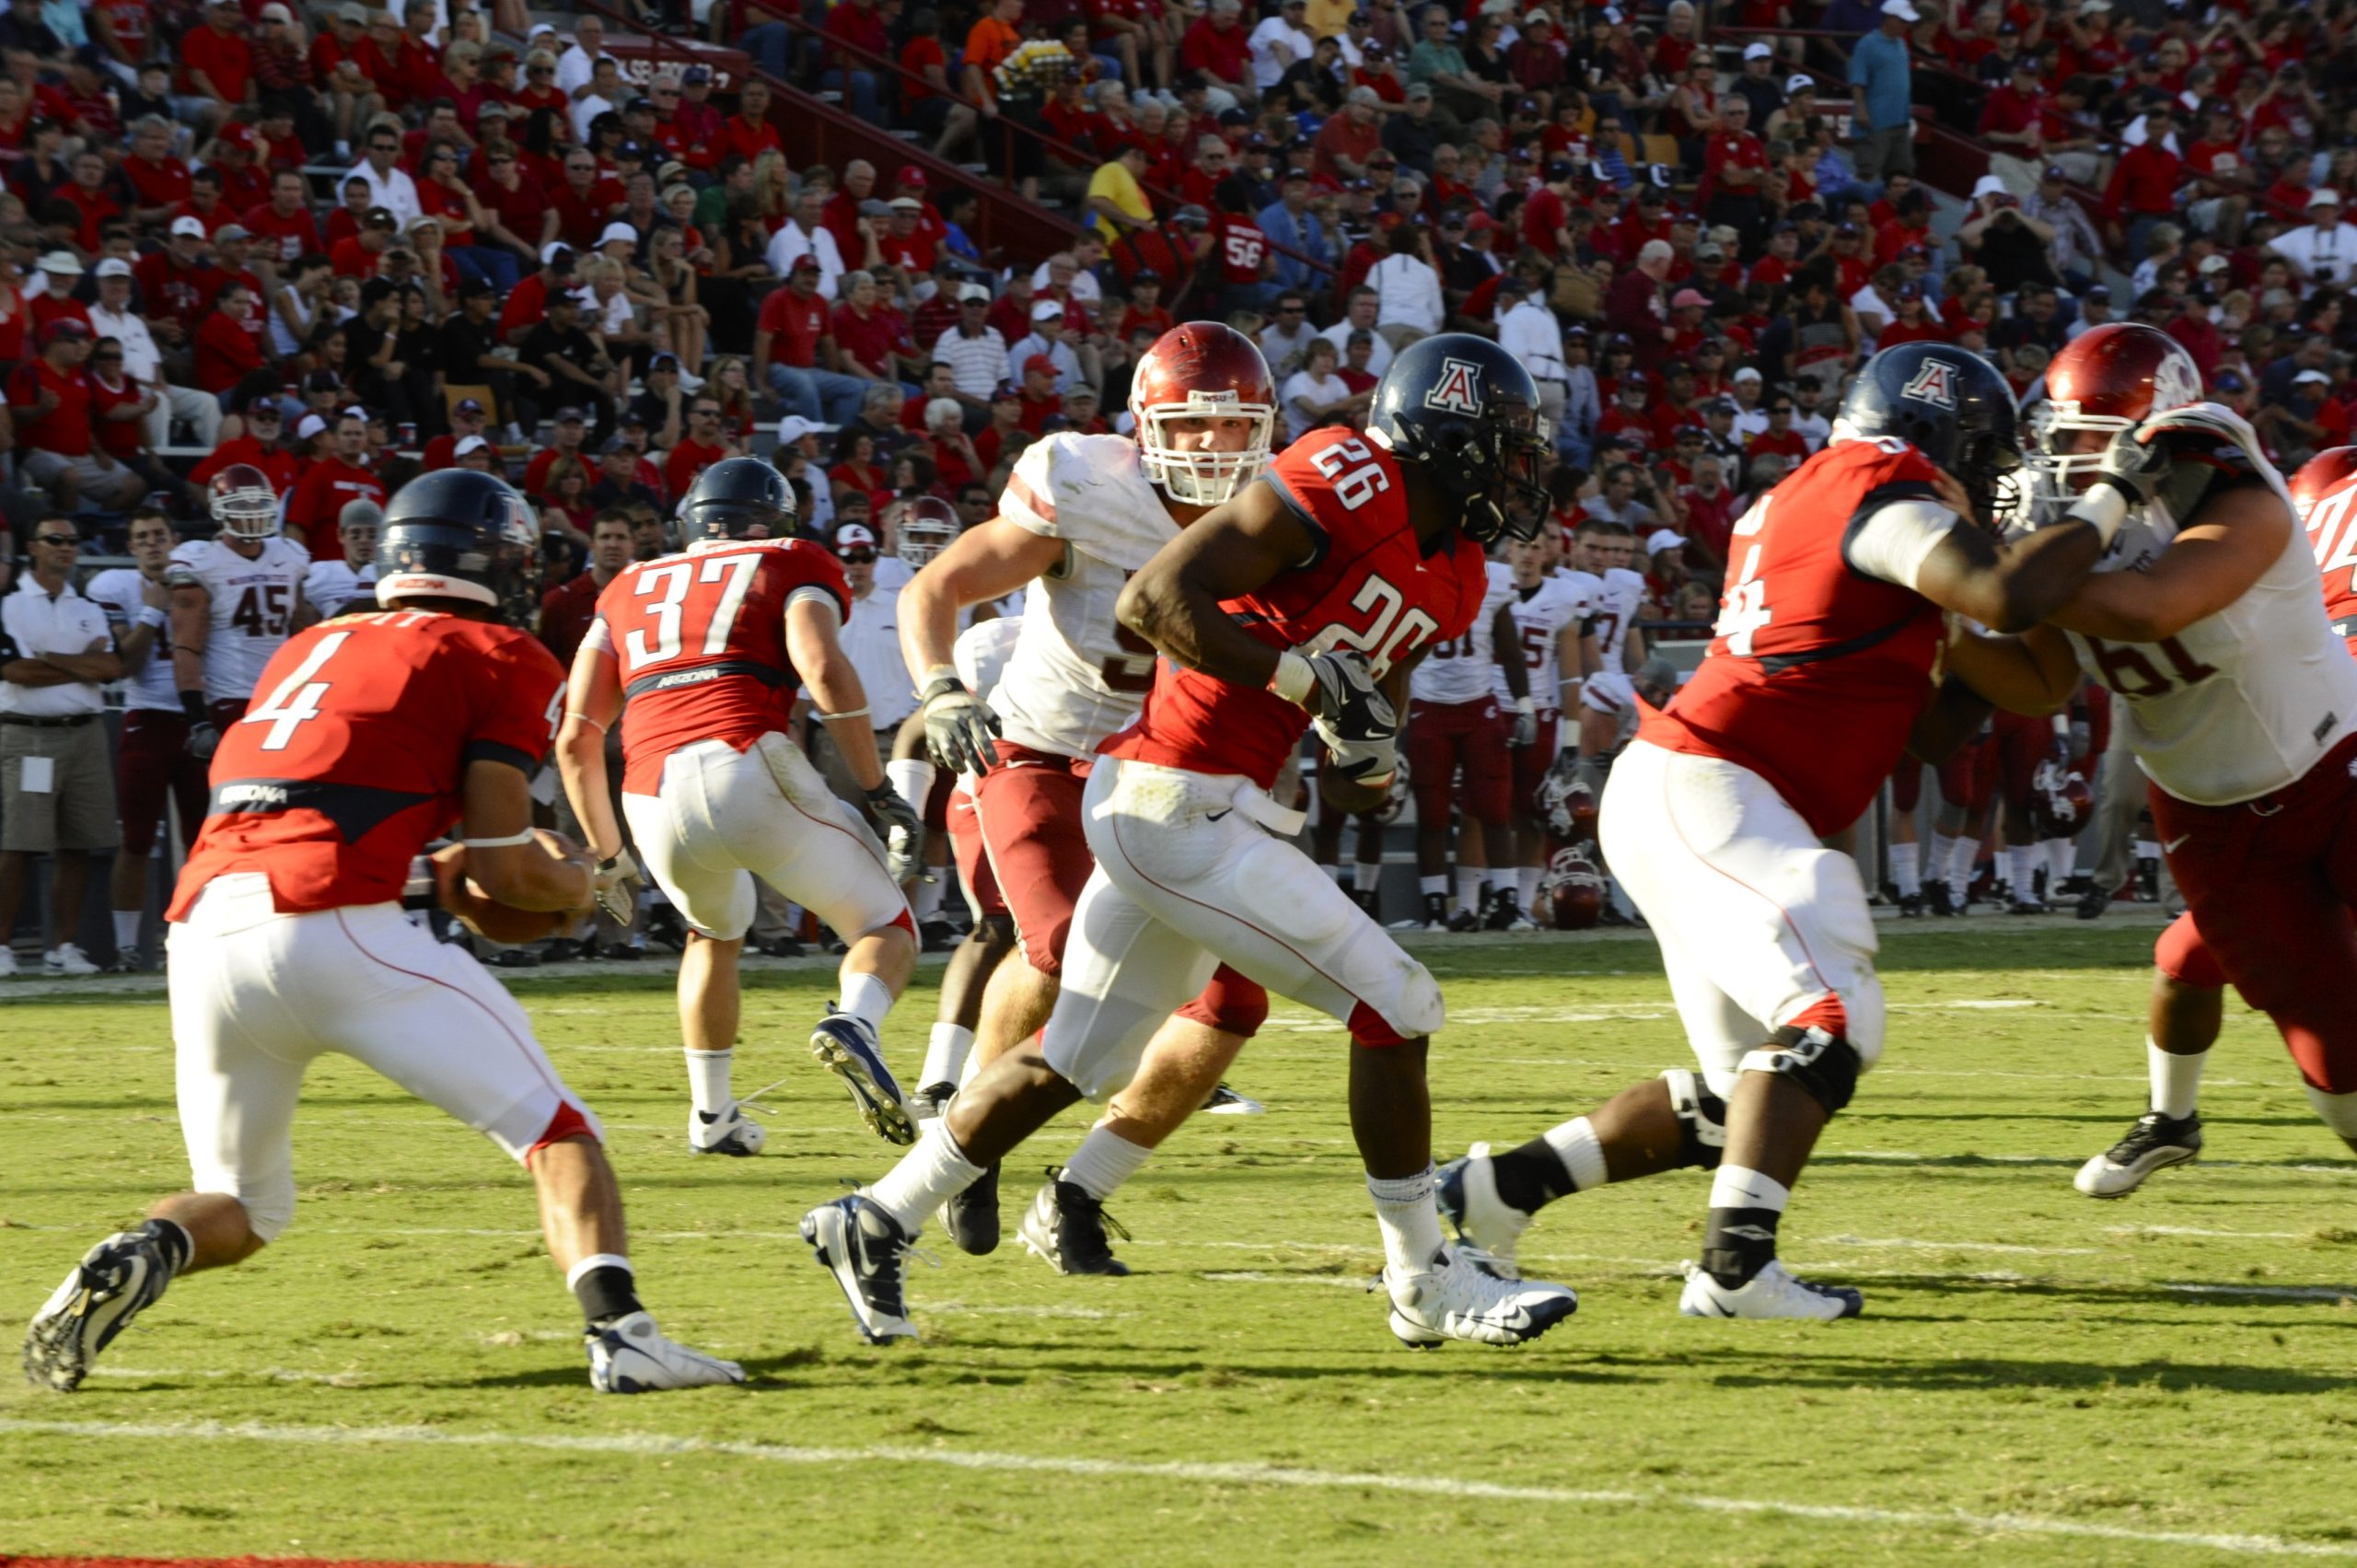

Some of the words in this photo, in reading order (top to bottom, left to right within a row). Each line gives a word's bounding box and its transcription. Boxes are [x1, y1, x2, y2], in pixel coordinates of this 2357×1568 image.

[1225, 237, 1263, 269] 56
[1424, 356, 1482, 419] A
[1900, 356, 1961, 412] A
[1308, 436, 1390, 512] 26
[232, 584, 288, 638] 45
[624, 552, 764, 671] 37
[1299, 571, 1440, 684] 26
[239, 630, 354, 753] 4
